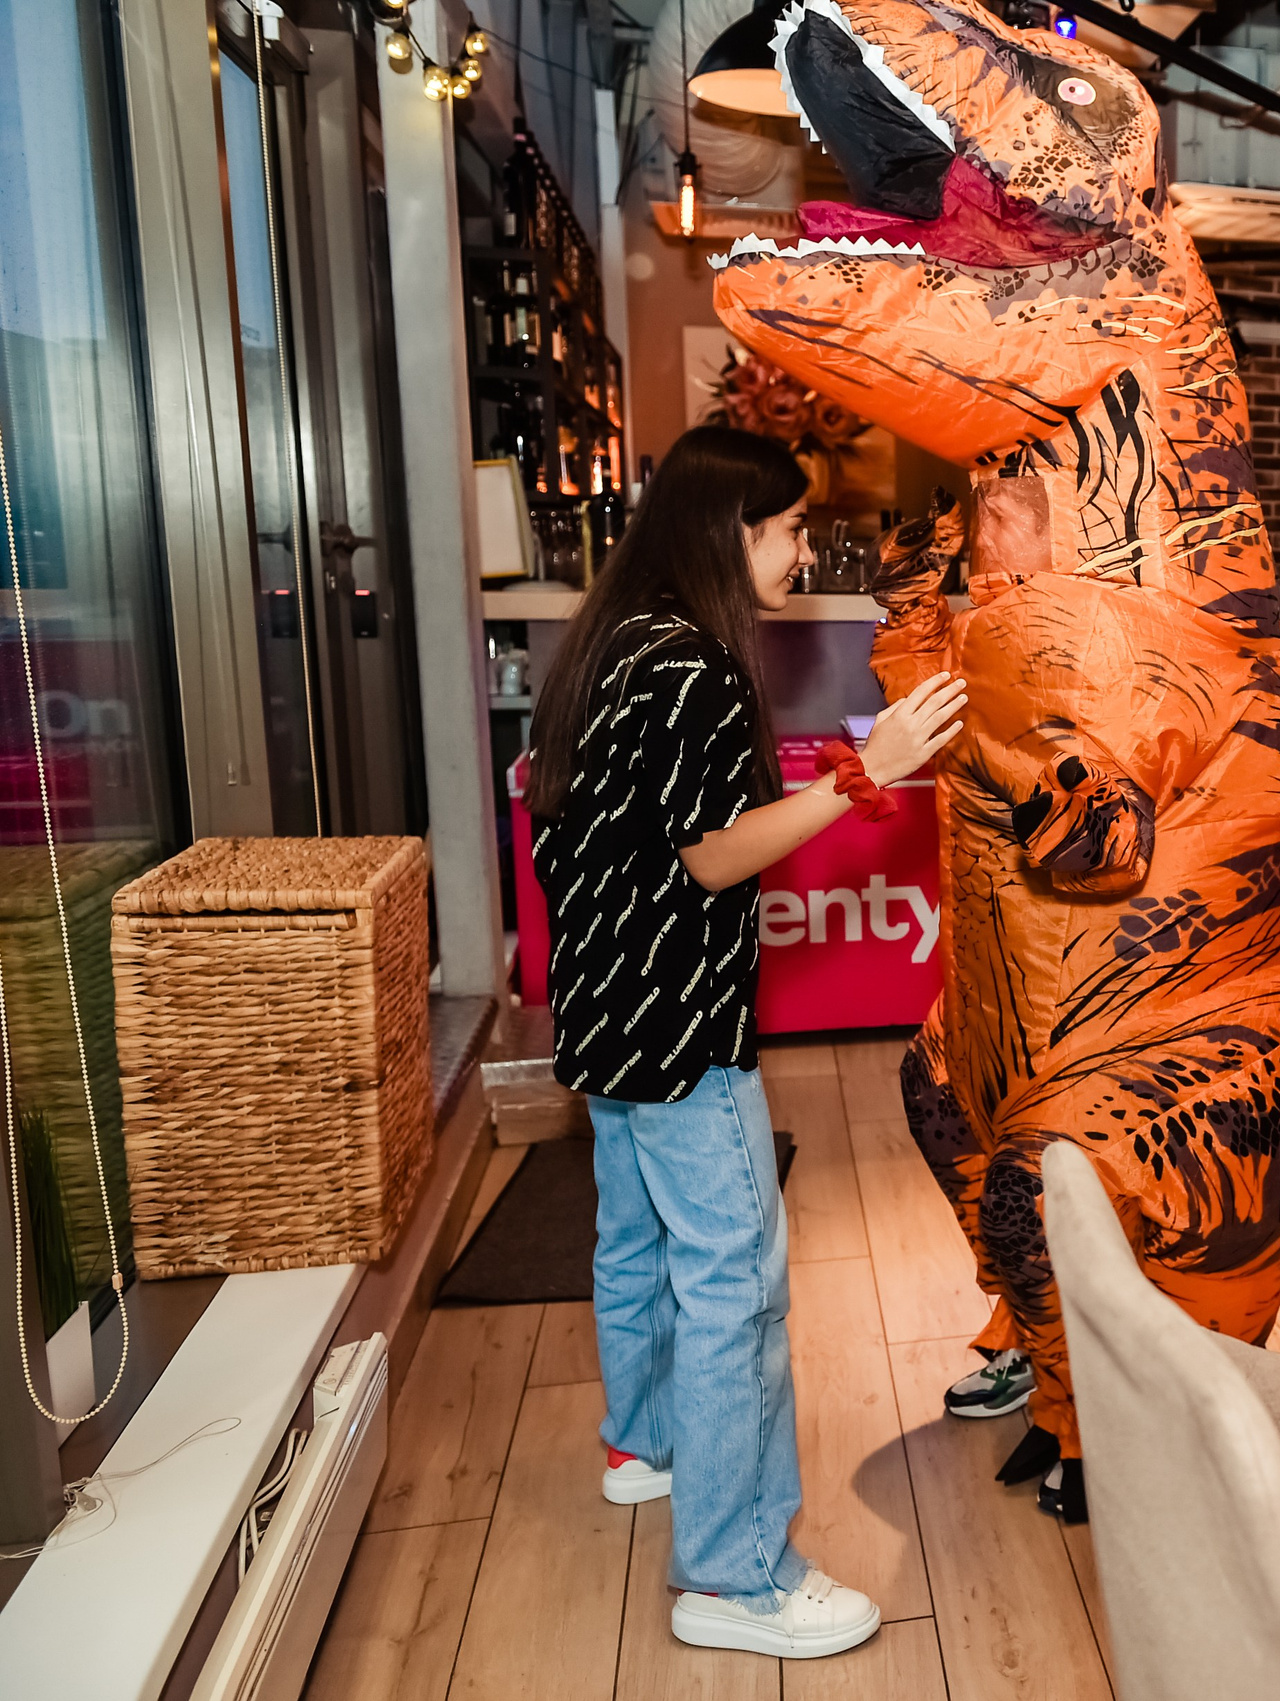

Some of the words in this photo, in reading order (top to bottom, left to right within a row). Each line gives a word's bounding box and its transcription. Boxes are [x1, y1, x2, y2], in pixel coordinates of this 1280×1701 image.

[666, 707, 681, 729] KARL
[652, 883, 670, 902] KARL
[661, 913, 677, 933] KARL
[758, 873, 940, 964] enty
[641, 932, 663, 976] LAGERFELD
[716, 953, 734, 973] KARL
[719, 984, 735, 1004] KARL
[660, 1054, 676, 1070] KARL
[673, 1011, 703, 1056] LAGERFELD
[627, 1050, 641, 1067] KARL
[603, 1064, 628, 1094] LAGERFELD
[671, 1080, 686, 1097] KARL
